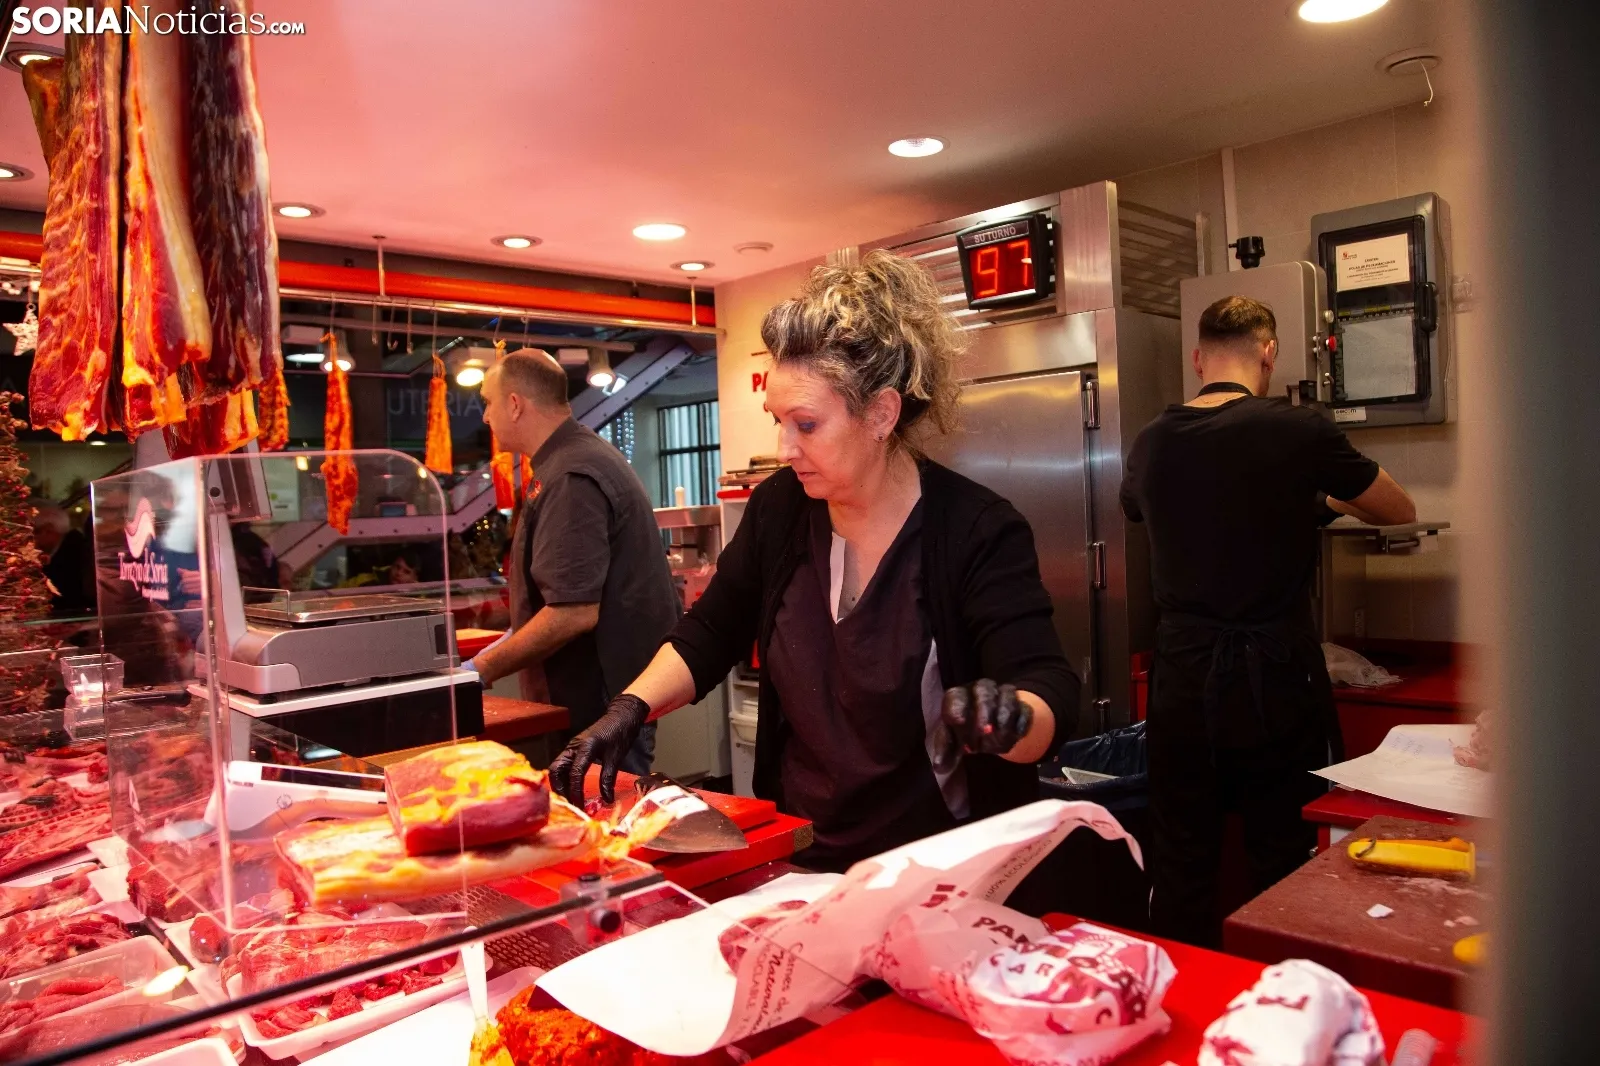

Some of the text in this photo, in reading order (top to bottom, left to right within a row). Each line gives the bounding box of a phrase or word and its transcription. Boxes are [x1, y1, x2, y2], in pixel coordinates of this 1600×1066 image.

[974, 226, 1017, 243] SU TURNO
[977, 239, 1029, 297] 97
